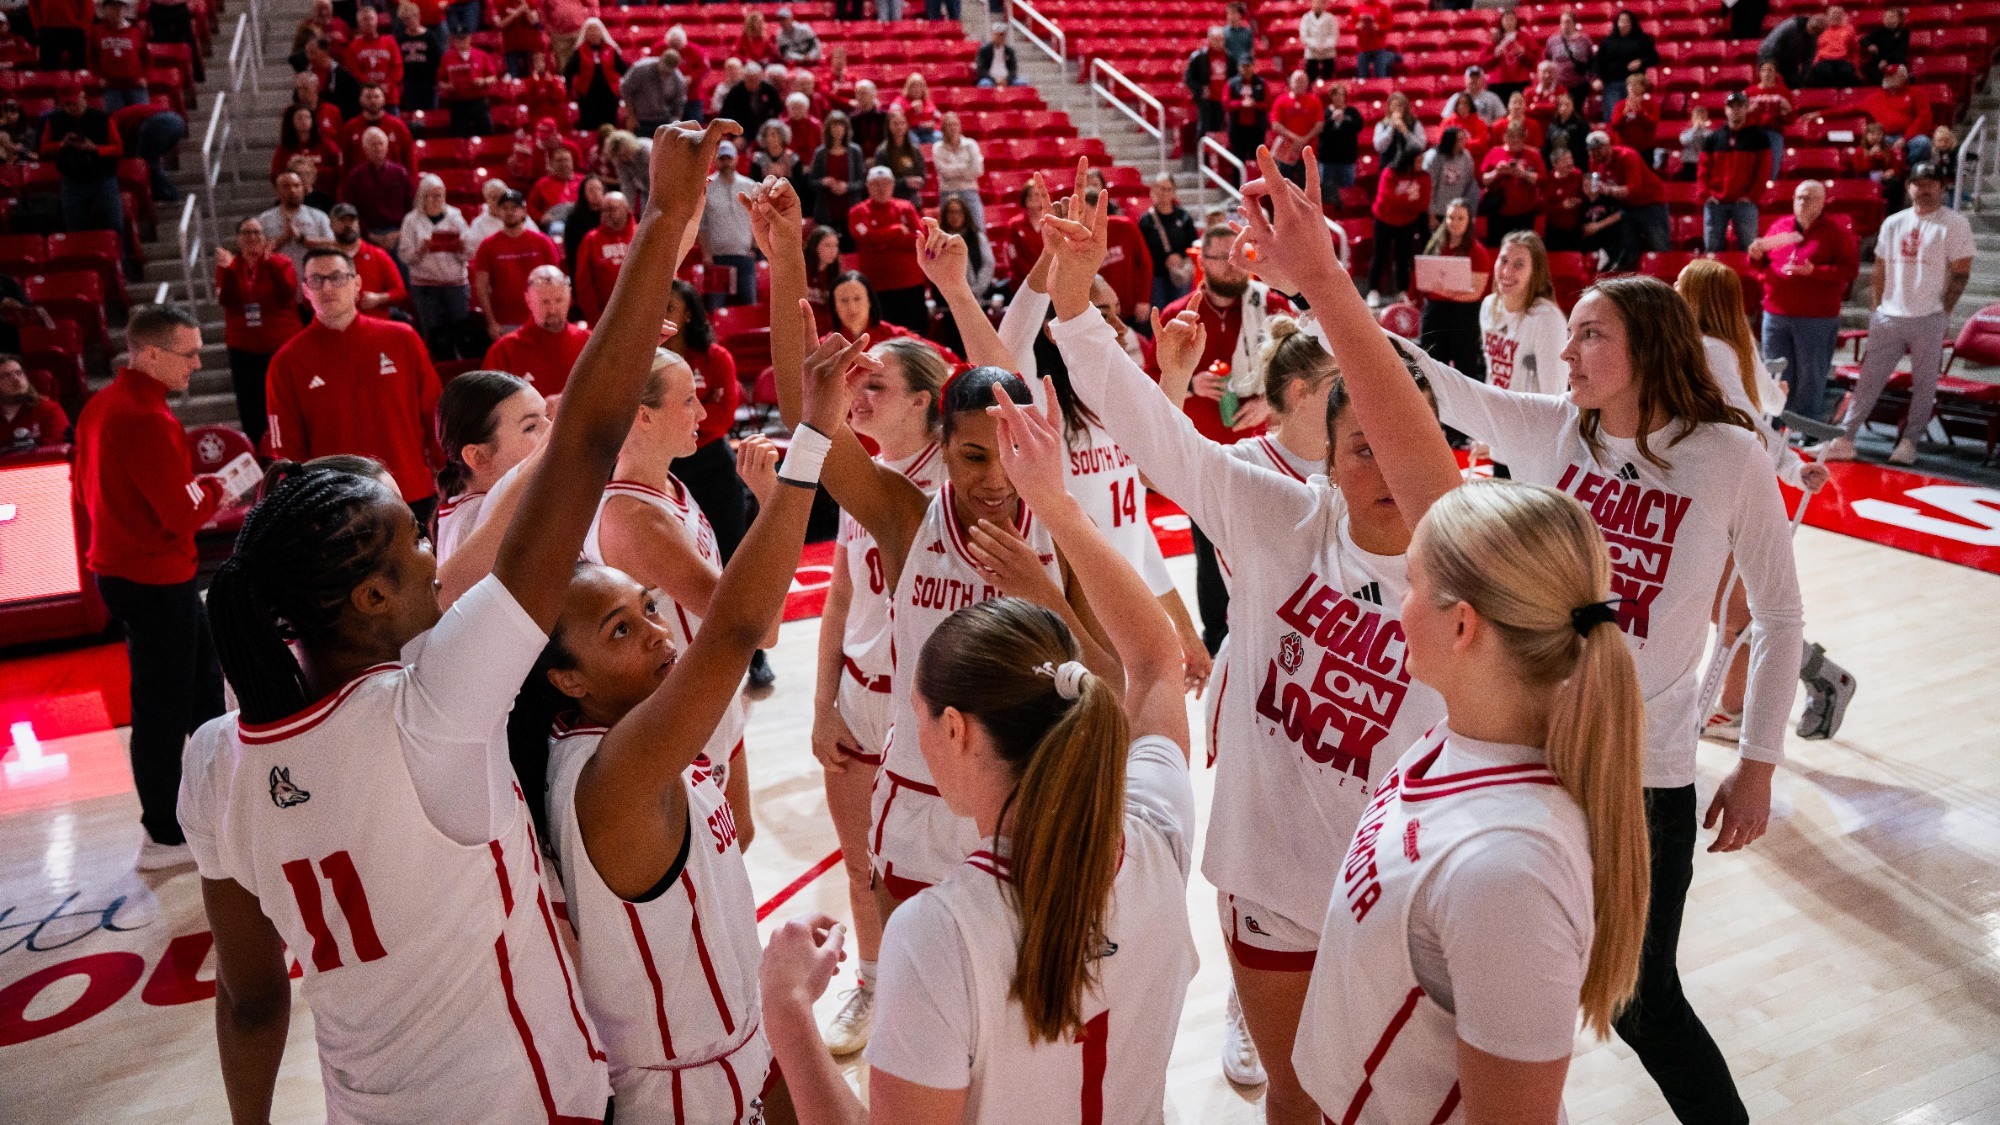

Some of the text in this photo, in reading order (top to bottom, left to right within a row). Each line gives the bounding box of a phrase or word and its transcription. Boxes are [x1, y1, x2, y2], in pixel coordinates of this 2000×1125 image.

[1070, 446, 1116, 477] SOUTH
[1109, 476, 1137, 528] 14
[1607, 541, 1662, 575] ON
[912, 574, 974, 612] SOUTH
[1324, 668, 1394, 717] ON
[1255, 657, 1390, 783] LOCK
[1344, 810, 1387, 924] DAKOTA
[282, 850, 389, 973] 11
[1073, 1007, 1111, 1125] 1
